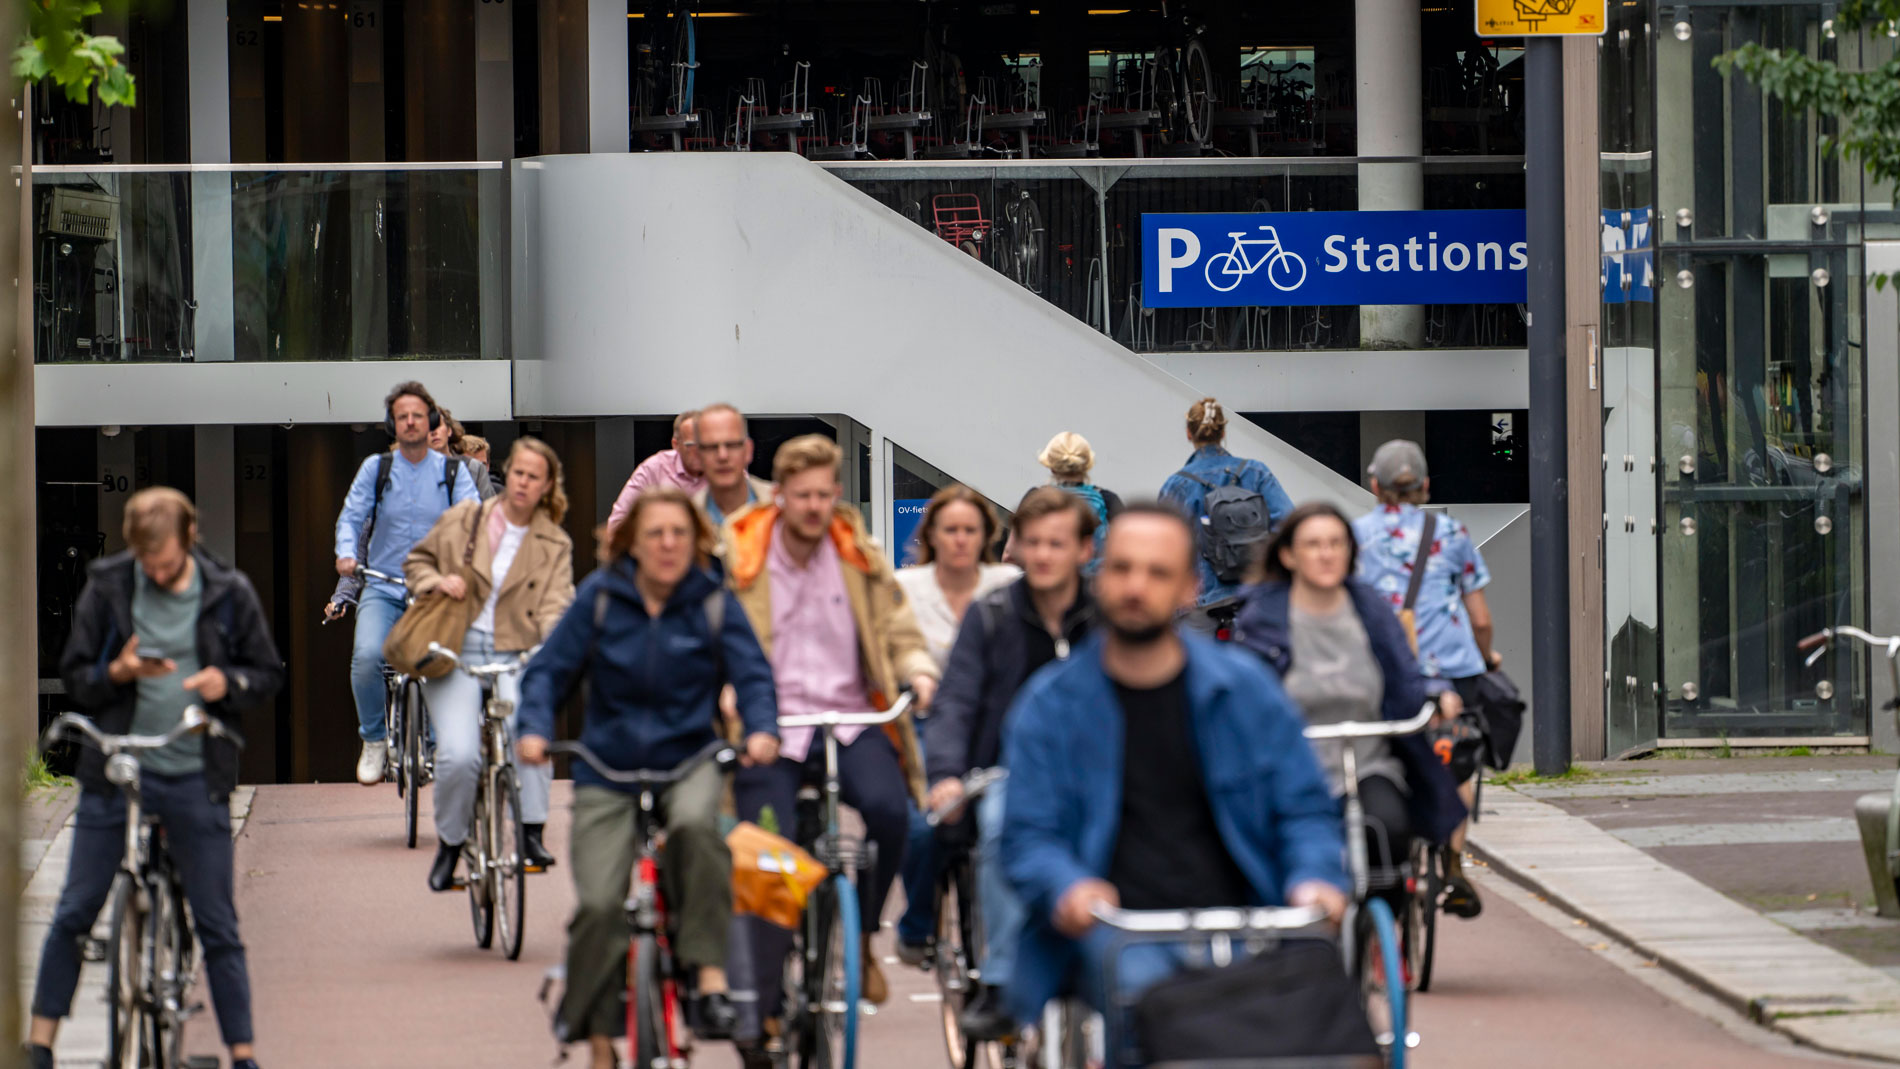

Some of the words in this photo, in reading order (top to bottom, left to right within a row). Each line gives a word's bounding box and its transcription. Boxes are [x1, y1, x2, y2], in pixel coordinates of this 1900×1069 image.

[353, 12, 376, 28] 61
[235, 30, 259, 46] 62
[1158, 228, 1201, 293] P
[1323, 232, 1529, 273] Stations
[244, 465, 267, 481] 32
